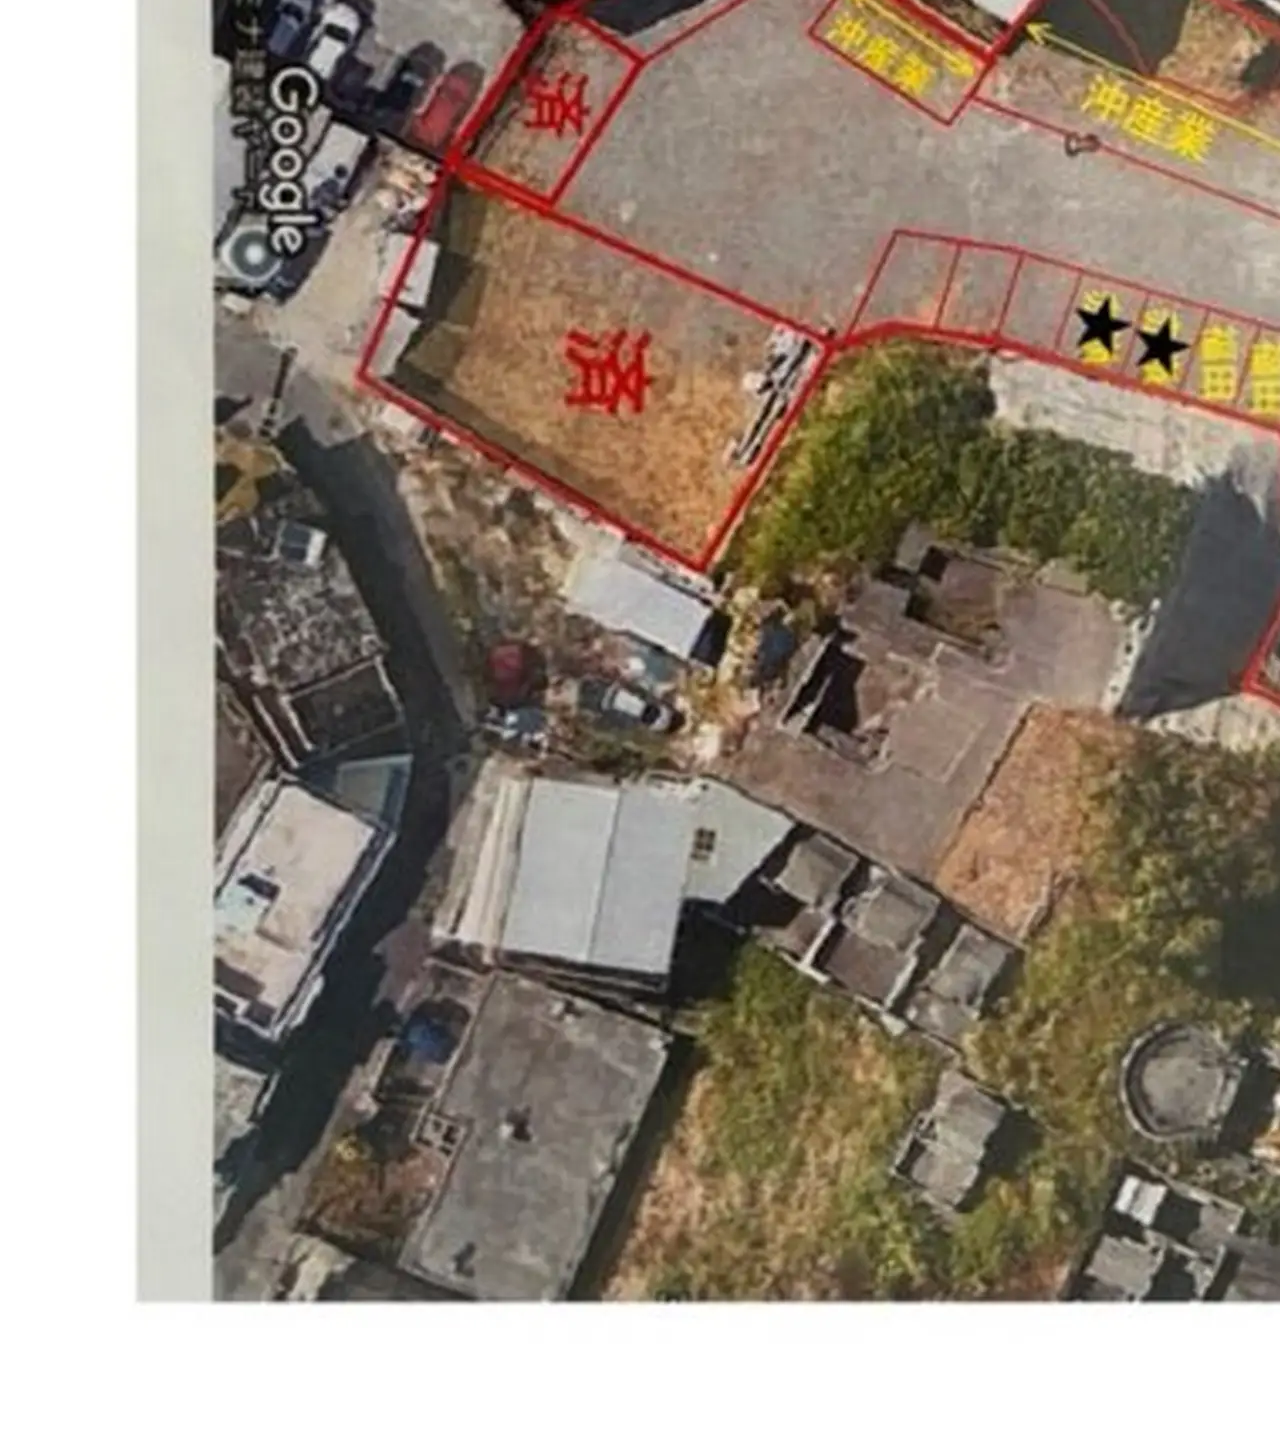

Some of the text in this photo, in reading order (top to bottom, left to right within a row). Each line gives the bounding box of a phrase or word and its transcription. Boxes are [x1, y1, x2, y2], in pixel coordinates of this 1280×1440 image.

[523, 70, 592, 138] 済
[1079, 73, 1217, 163] 沖産業
[258, 66, 319, 254] Google
[565, 328, 655, 415] 済
